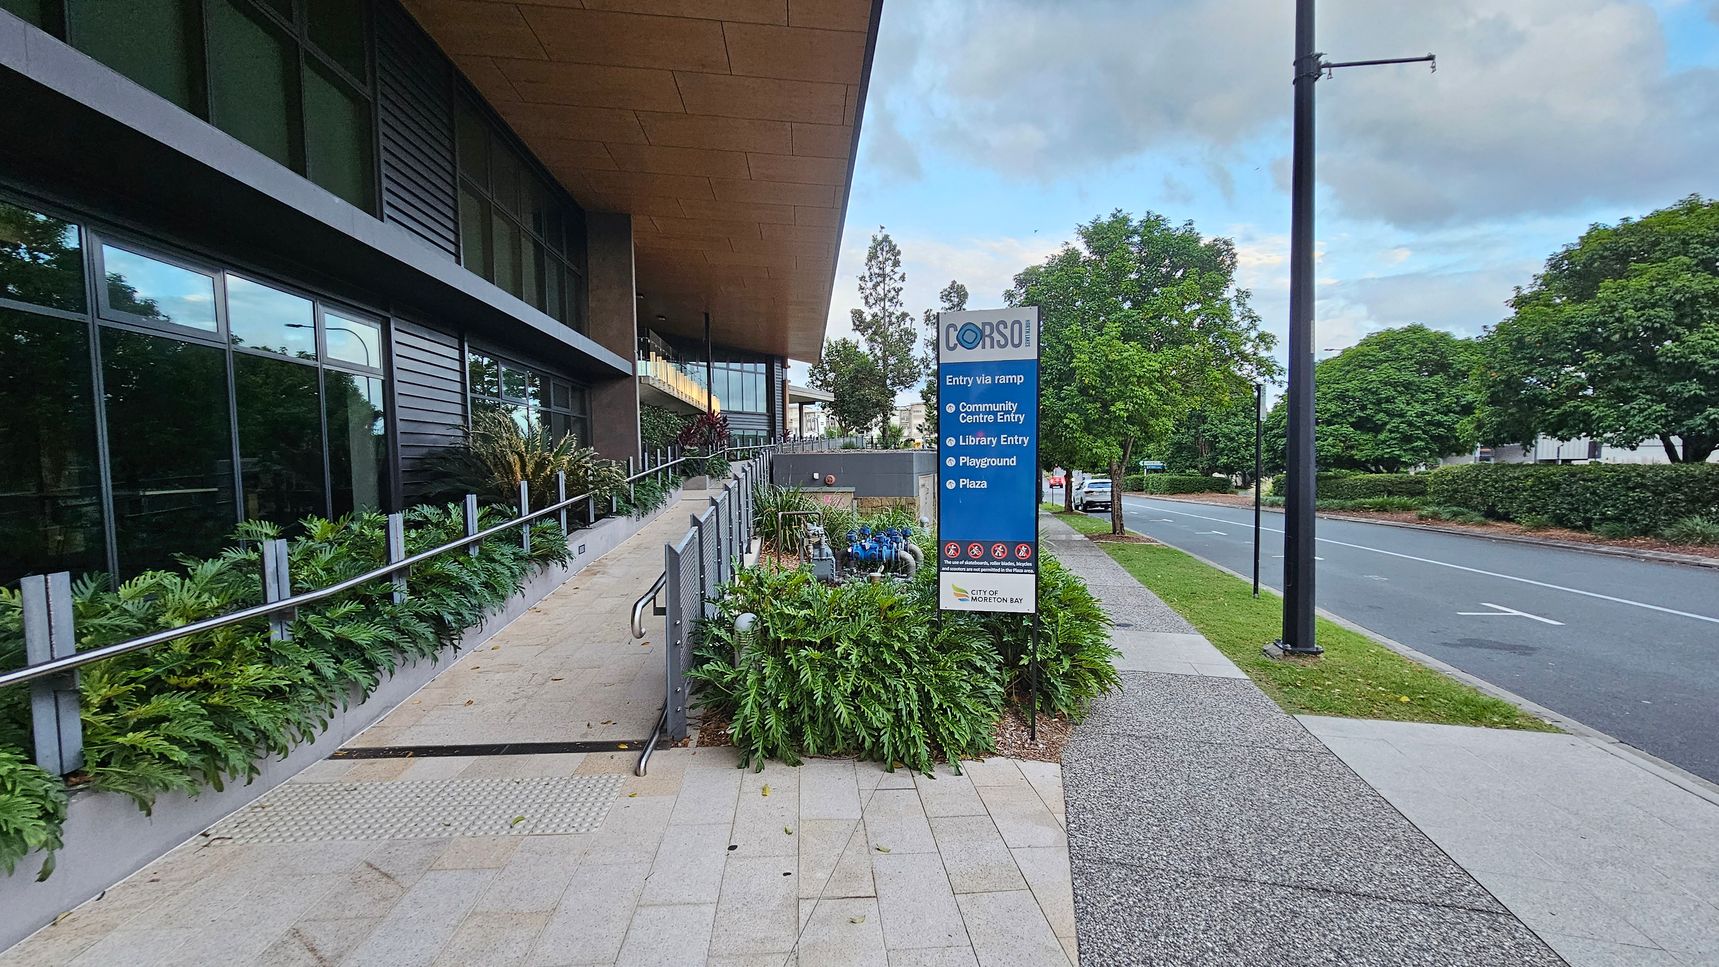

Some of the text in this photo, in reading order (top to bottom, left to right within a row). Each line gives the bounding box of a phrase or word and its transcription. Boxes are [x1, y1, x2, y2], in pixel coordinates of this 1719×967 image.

[945, 319, 1023, 352] CORSO
[946, 374, 1024, 387] Entry via ramp
[959, 401, 1018, 413] Community
[959, 412, 1025, 424] Centre Entry
[959, 434, 1029, 447] Library Entry
[959, 456, 1017, 469] Playground
[959, 478, 988, 489] Plaza
